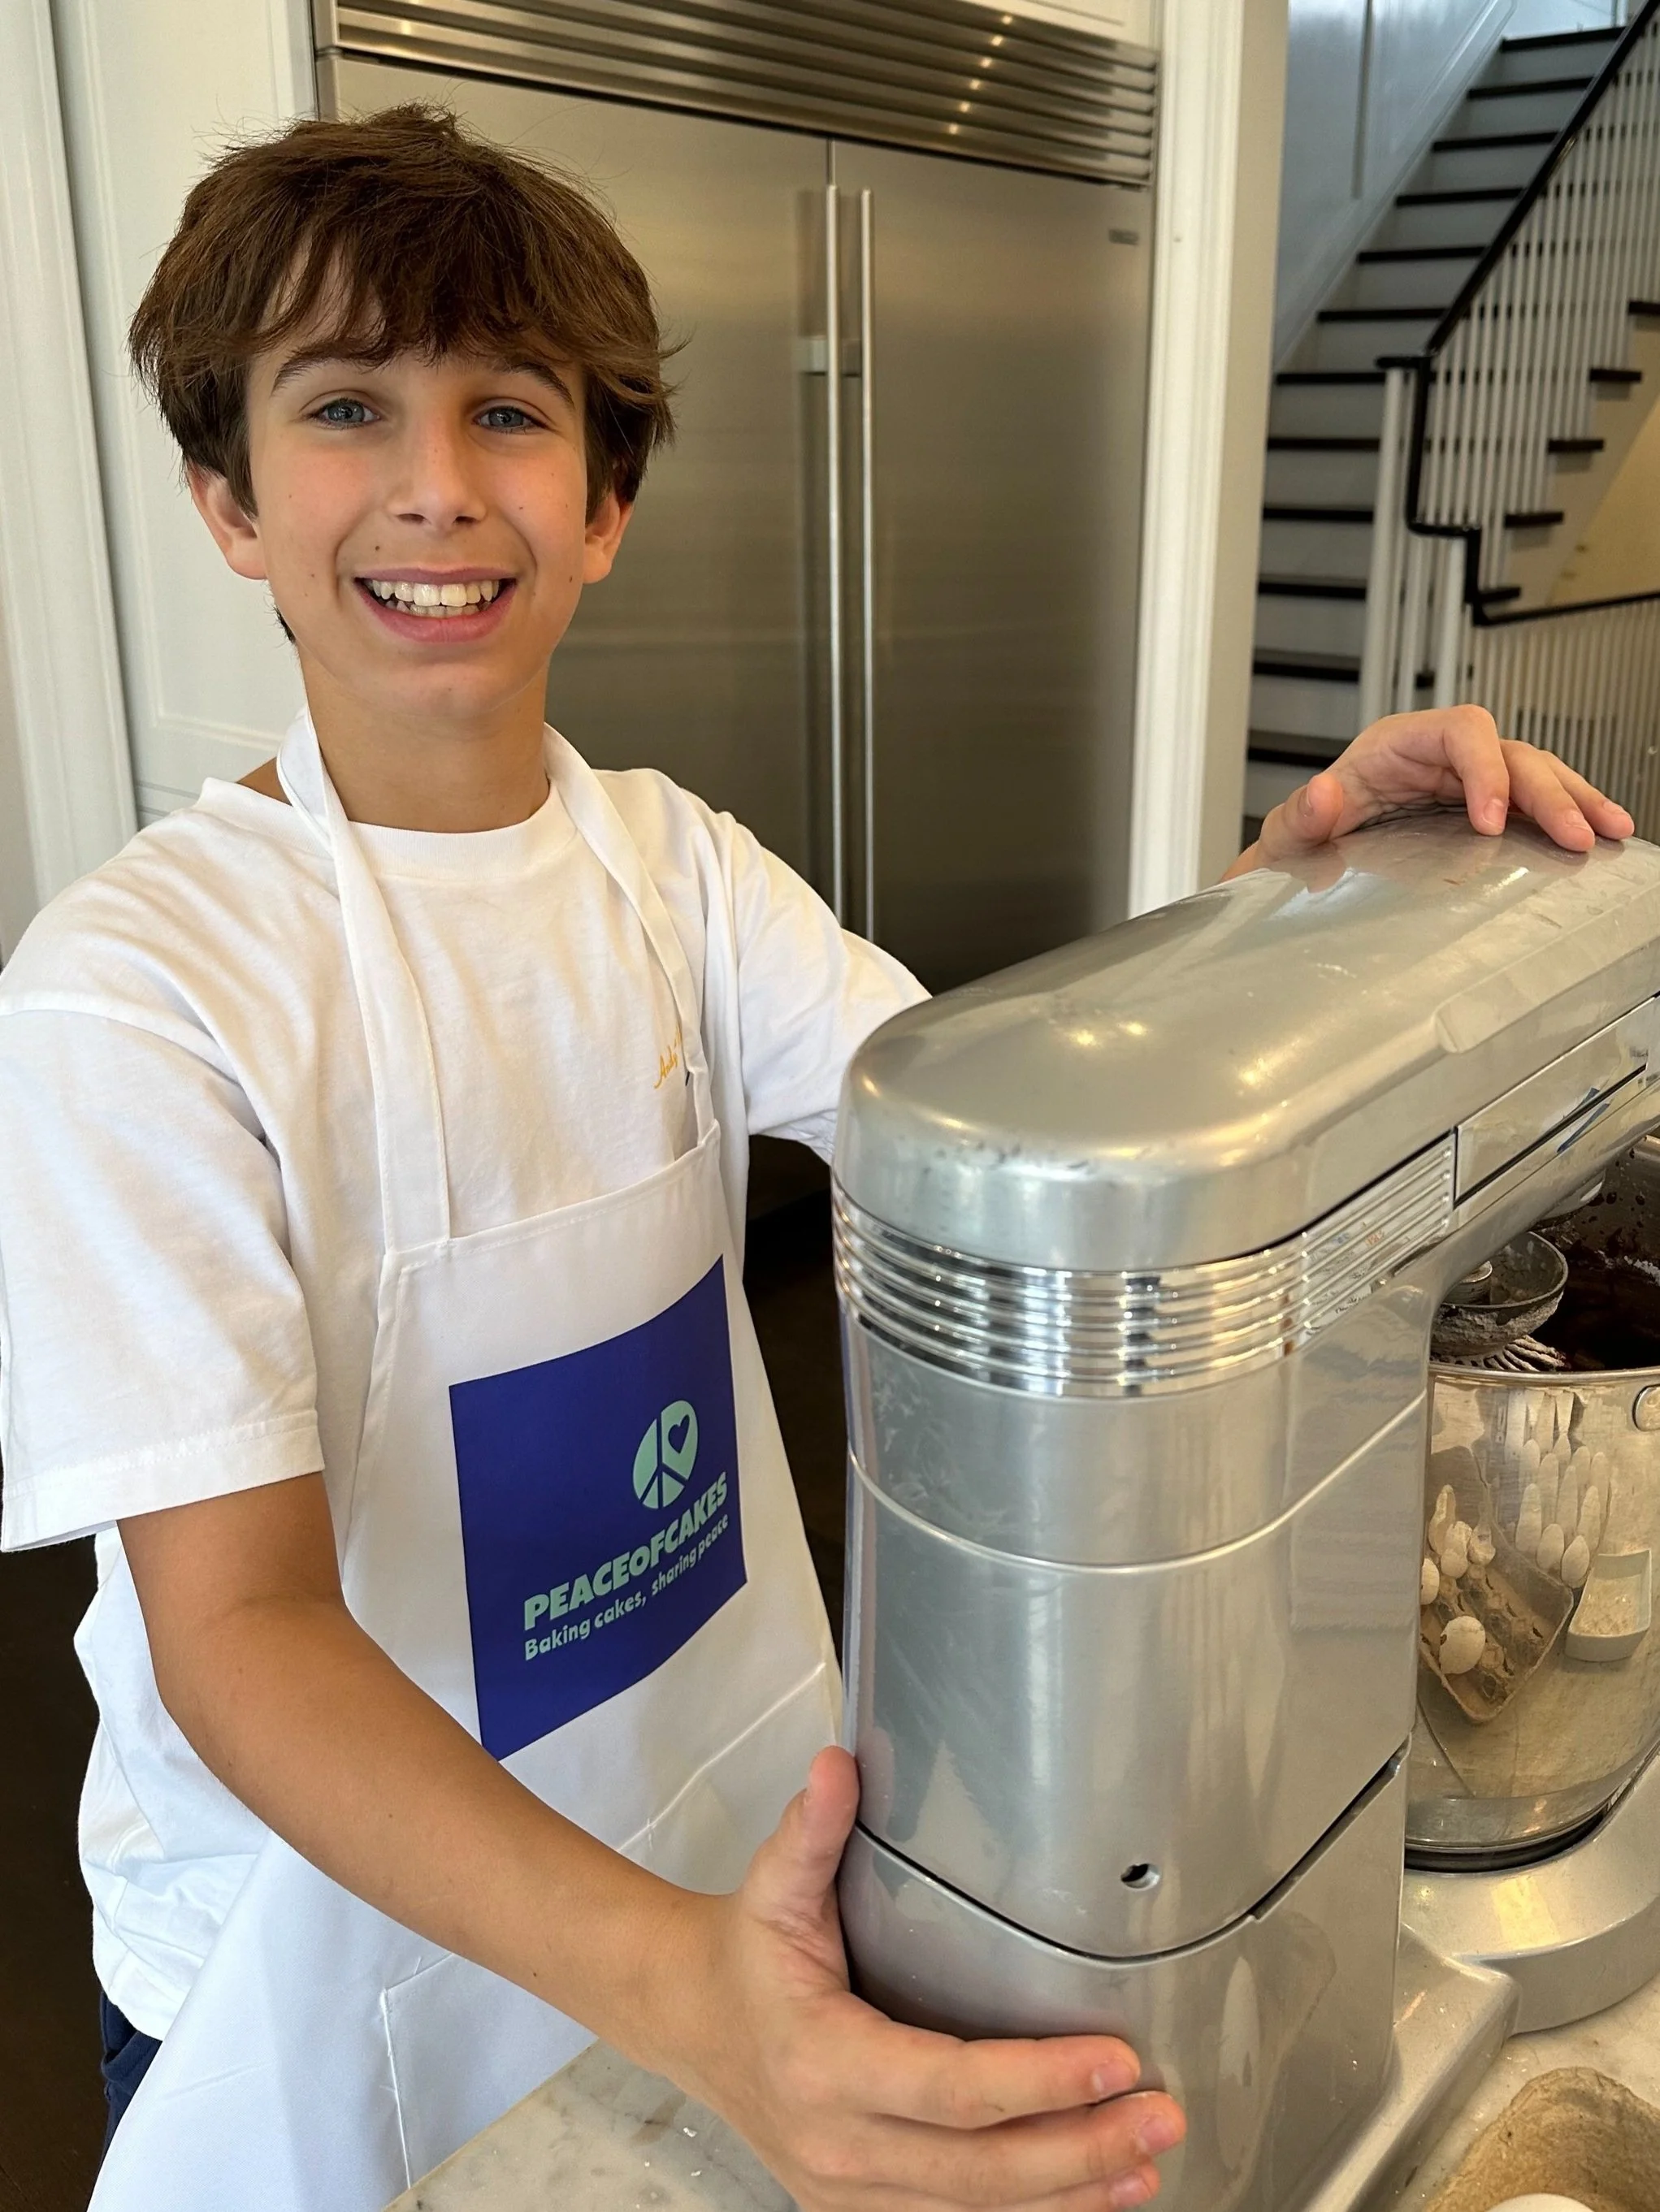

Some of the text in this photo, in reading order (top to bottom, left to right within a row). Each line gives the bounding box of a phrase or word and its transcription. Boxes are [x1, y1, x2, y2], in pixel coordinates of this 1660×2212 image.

[524, 1471, 728, 1630] PEACEOFCAKES
[525, 1514, 729, 1660] Baking cakes, sharing peace
